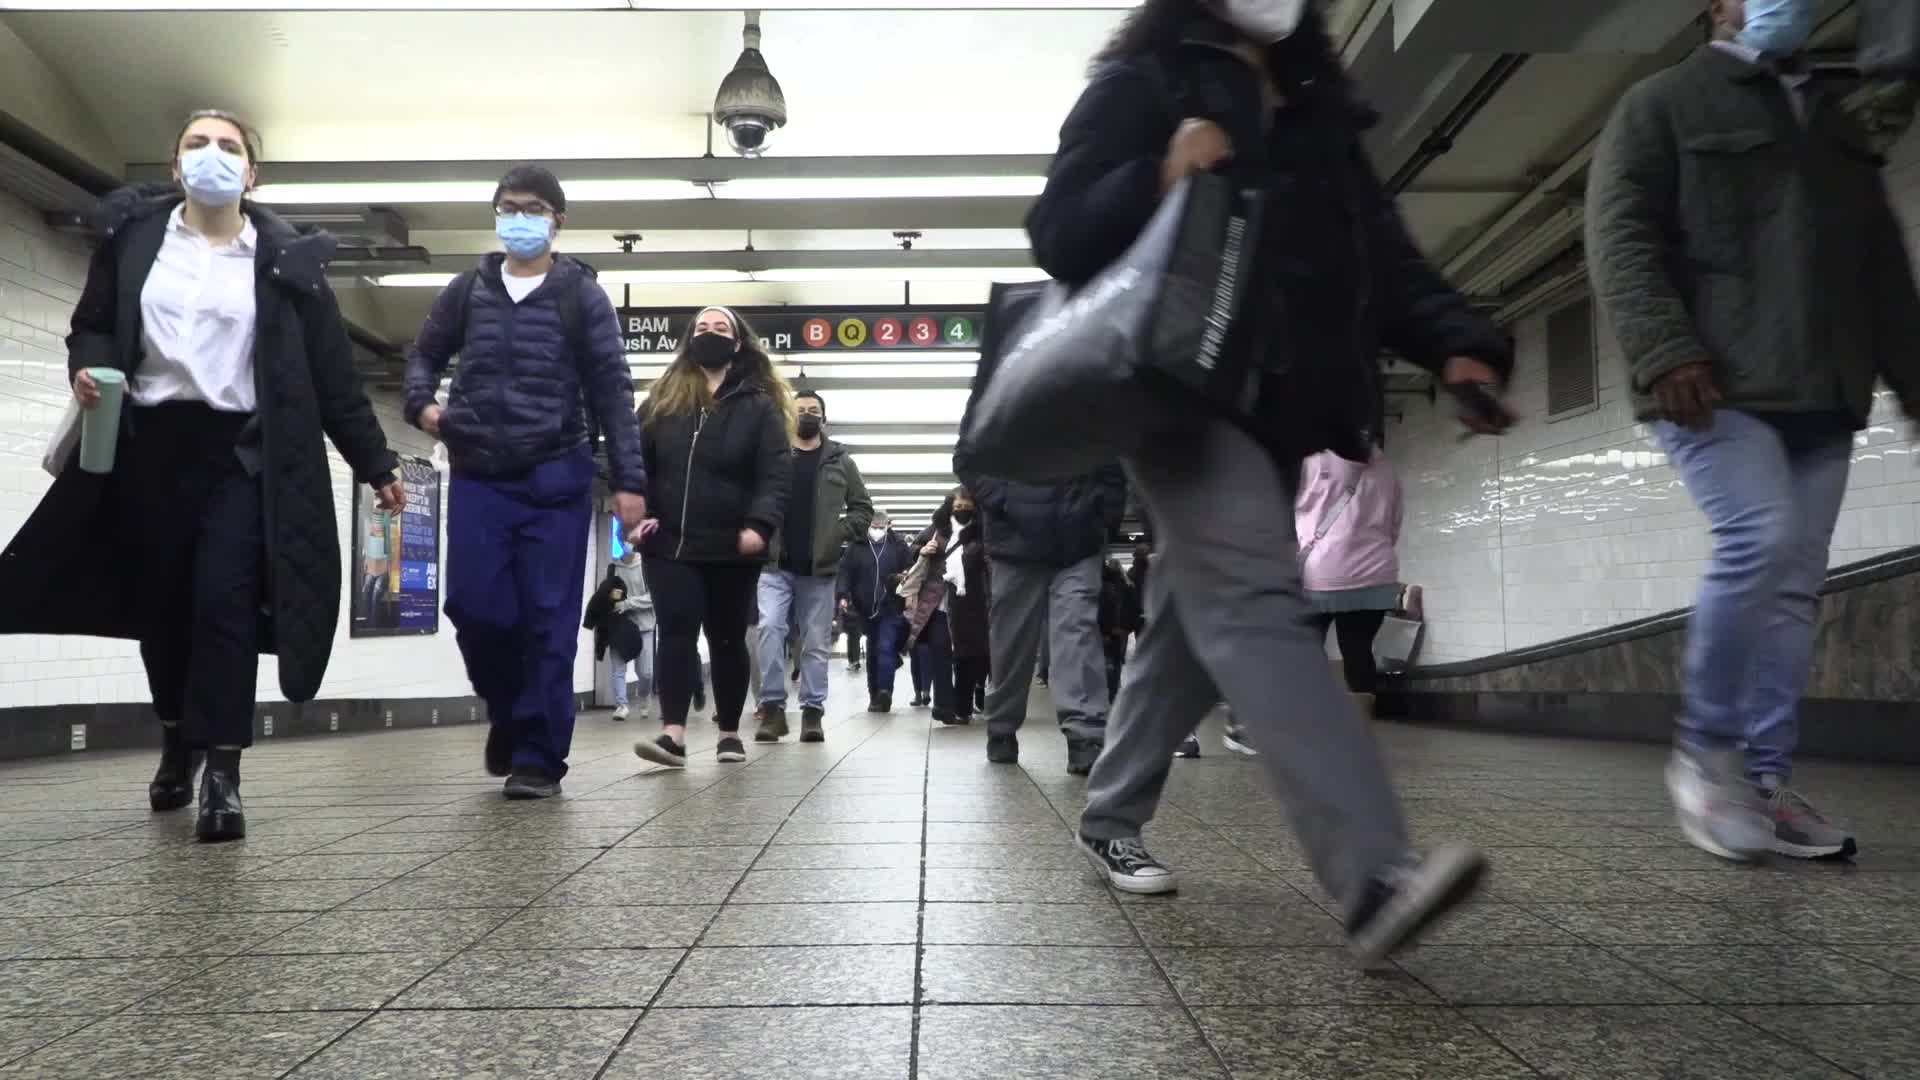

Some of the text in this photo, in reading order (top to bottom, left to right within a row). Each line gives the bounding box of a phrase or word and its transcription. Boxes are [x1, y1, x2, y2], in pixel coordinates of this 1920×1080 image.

[629, 317, 669, 333] BAM
[810, 324, 963, 341] B Q 2 3 4
[624, 335, 651, 350] ush
[656, 334, 678, 350] Av
